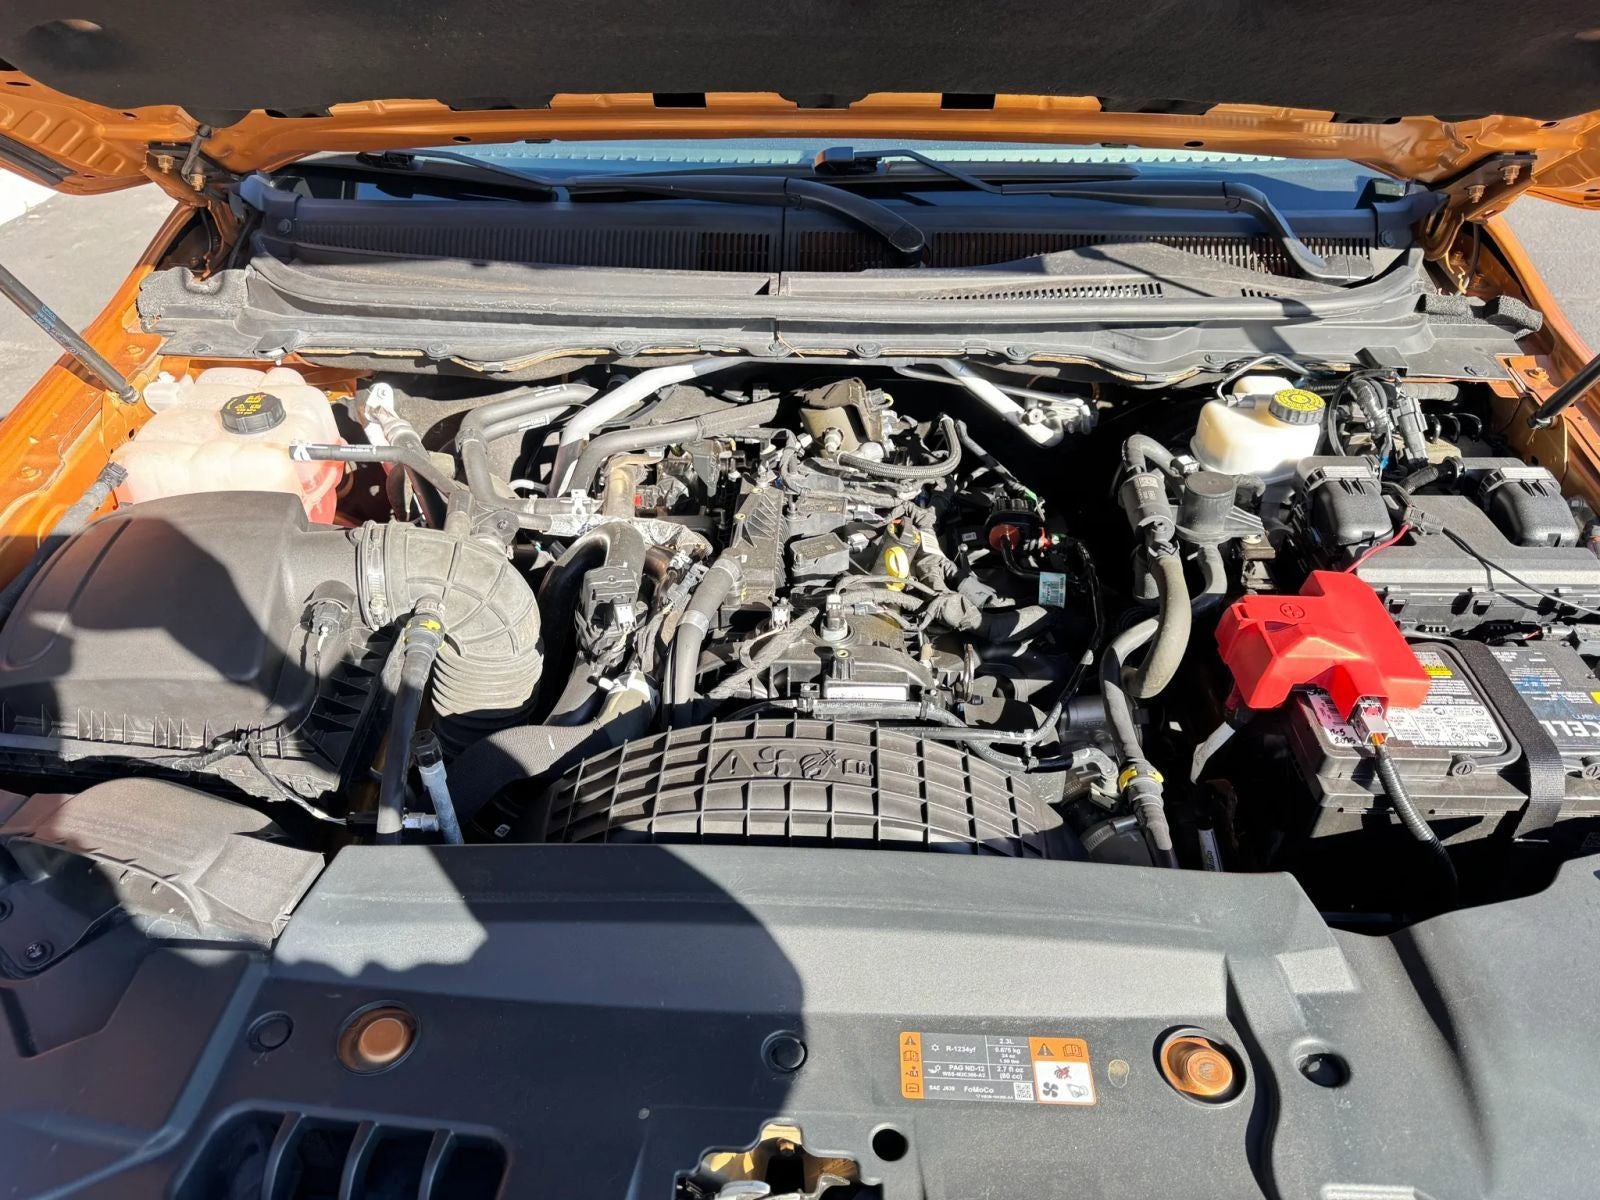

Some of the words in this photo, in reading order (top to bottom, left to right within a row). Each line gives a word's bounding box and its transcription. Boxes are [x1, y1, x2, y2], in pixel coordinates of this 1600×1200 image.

[1538, 720, 1600, 737] CELL
[946, 1045, 976, 1054] R-1234yf
[963, 1085, 994, 1094] FoMoCo
